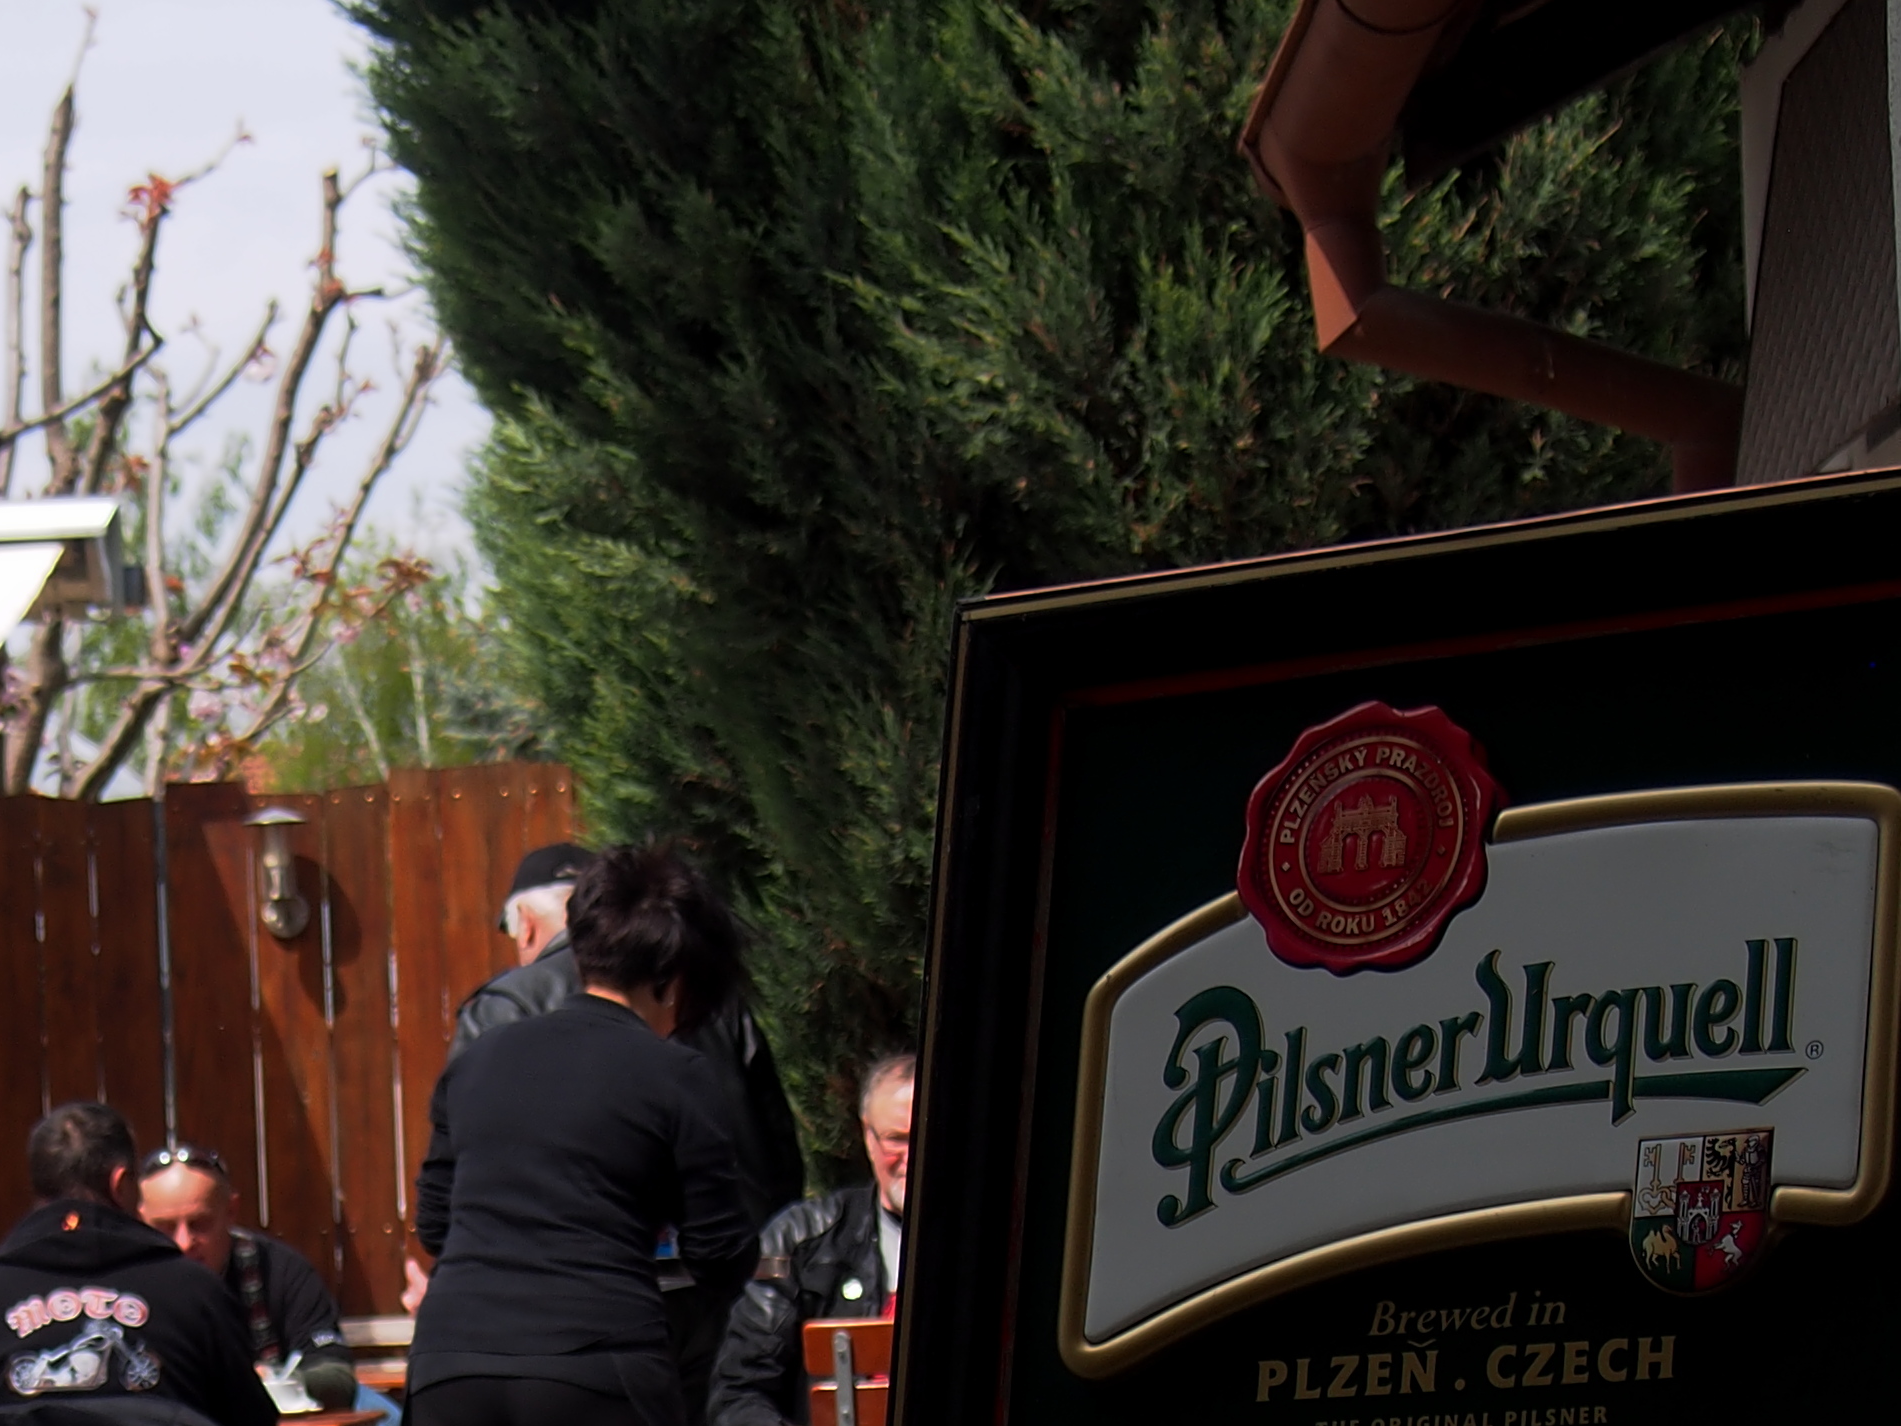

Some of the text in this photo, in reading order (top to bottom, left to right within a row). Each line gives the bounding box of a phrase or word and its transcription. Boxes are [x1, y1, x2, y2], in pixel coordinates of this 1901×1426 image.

[1375, 745, 1455, 829] PRAZDROJ
[1288, 877, 1434, 935] OD ROKU 1842
[1151, 936, 1801, 1229] Pilsner Urquell
[1368, 1289, 1567, 1338] Brewed in
[1255, 1334, 1677, 1403] PLZEŇ CZECH
